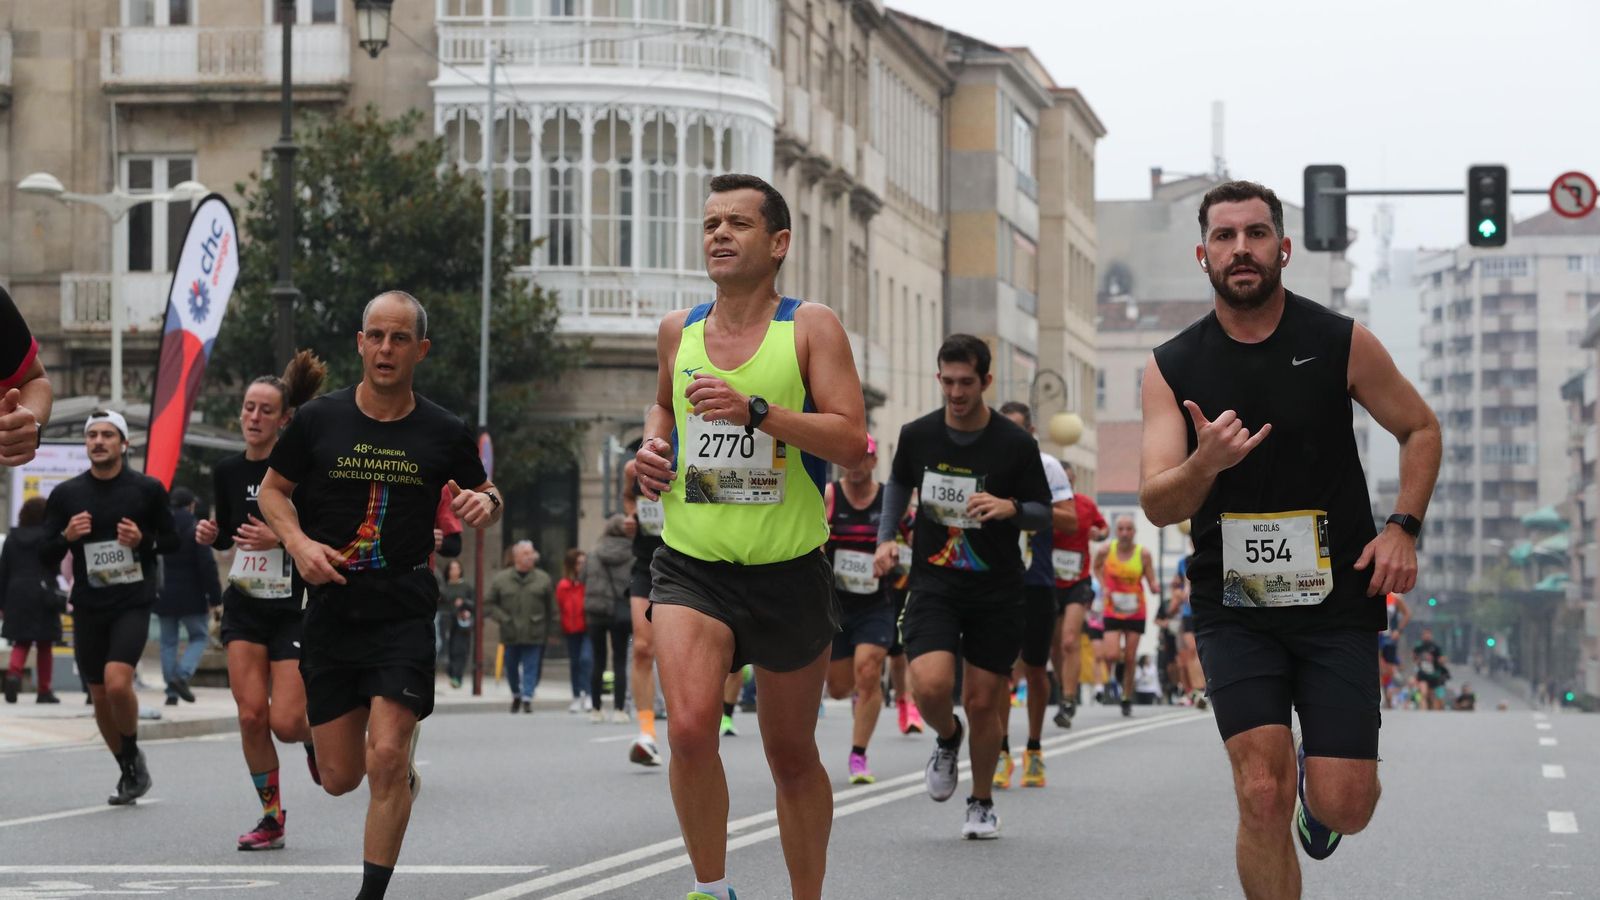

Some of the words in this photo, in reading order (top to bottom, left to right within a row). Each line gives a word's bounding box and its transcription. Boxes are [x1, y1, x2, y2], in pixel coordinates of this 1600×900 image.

[202, 218, 223, 275] chc
[372, 448, 406, 457] CARREIRA
[698, 433, 755, 458] 2770
[337, 457, 361, 468] SAN
[364, 458, 418, 474] MARTIÑO
[328, 470, 372, 480] CONCELLO
[373, 473, 385, 482] DE
[750, 477, 778, 486] XLVIII
[931, 485, 965, 503] 1386
[1252, 522, 1280, 533] NICOLÁS
[93, 550, 125, 566] 2088
[1245, 538, 1292, 564] 554
[242, 556, 268, 572] 712
[840, 558, 868, 574] 2386
[1298, 578, 1326, 588] XLVIII
